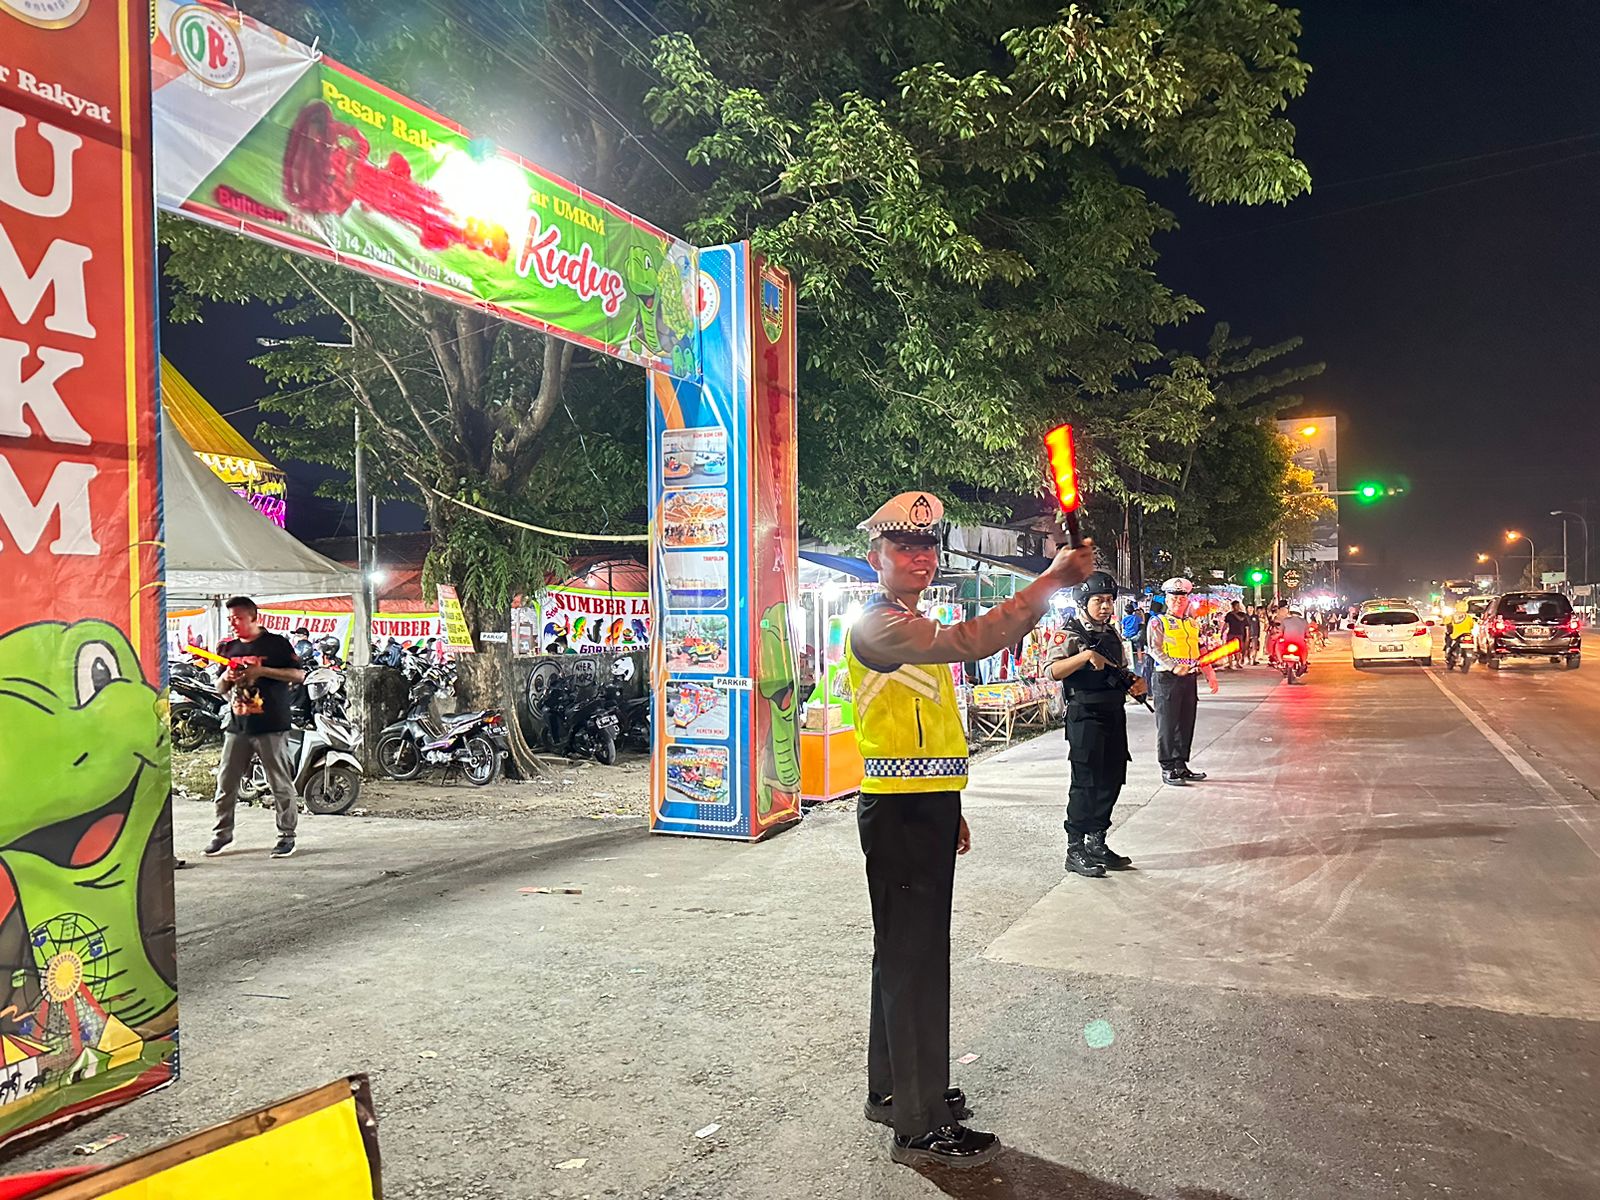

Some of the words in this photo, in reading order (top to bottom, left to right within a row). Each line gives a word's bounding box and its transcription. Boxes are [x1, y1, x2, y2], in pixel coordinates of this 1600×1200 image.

[17, 69, 111, 123] Rakyat
[321, 79, 386, 130] Pasar
[392, 114, 437, 151] Rak
[553, 195, 605, 236] UMKM
[344, 230, 361, 252] 14
[362, 241, 396, 265] April
[518, 212, 625, 314] Kudus
[256, 613, 290, 631] MBER
[631, 599, 649, 615] LA
[372, 620, 430, 637] SUMBER
[717, 678, 748, 687] PARKIR
